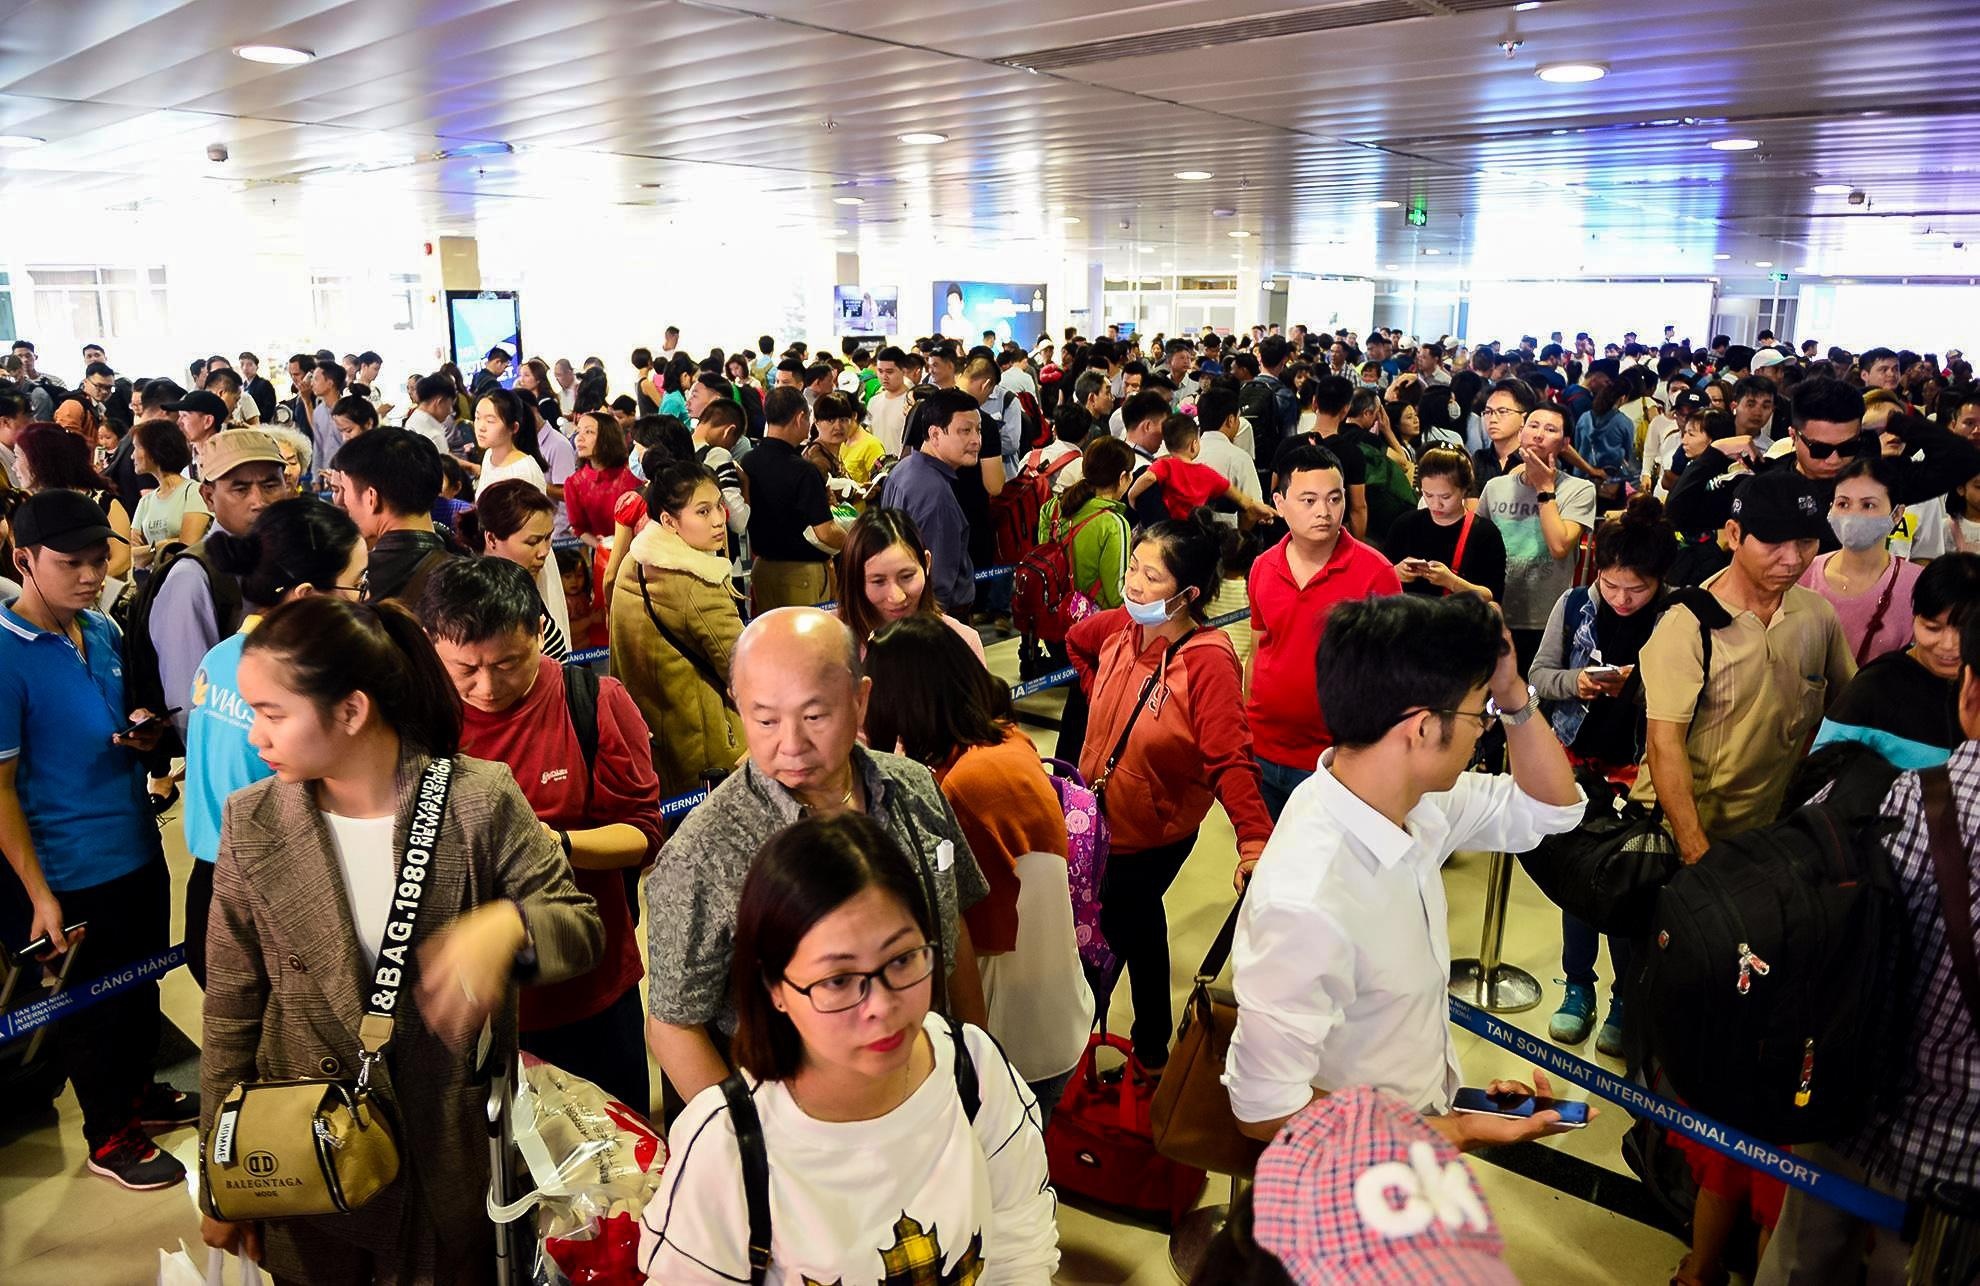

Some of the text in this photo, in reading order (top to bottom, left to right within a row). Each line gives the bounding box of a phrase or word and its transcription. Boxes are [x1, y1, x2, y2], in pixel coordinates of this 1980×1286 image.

[1486, 1020, 1821, 1187] TAN SON NHAT INTERNATIONAL AIRPORT
